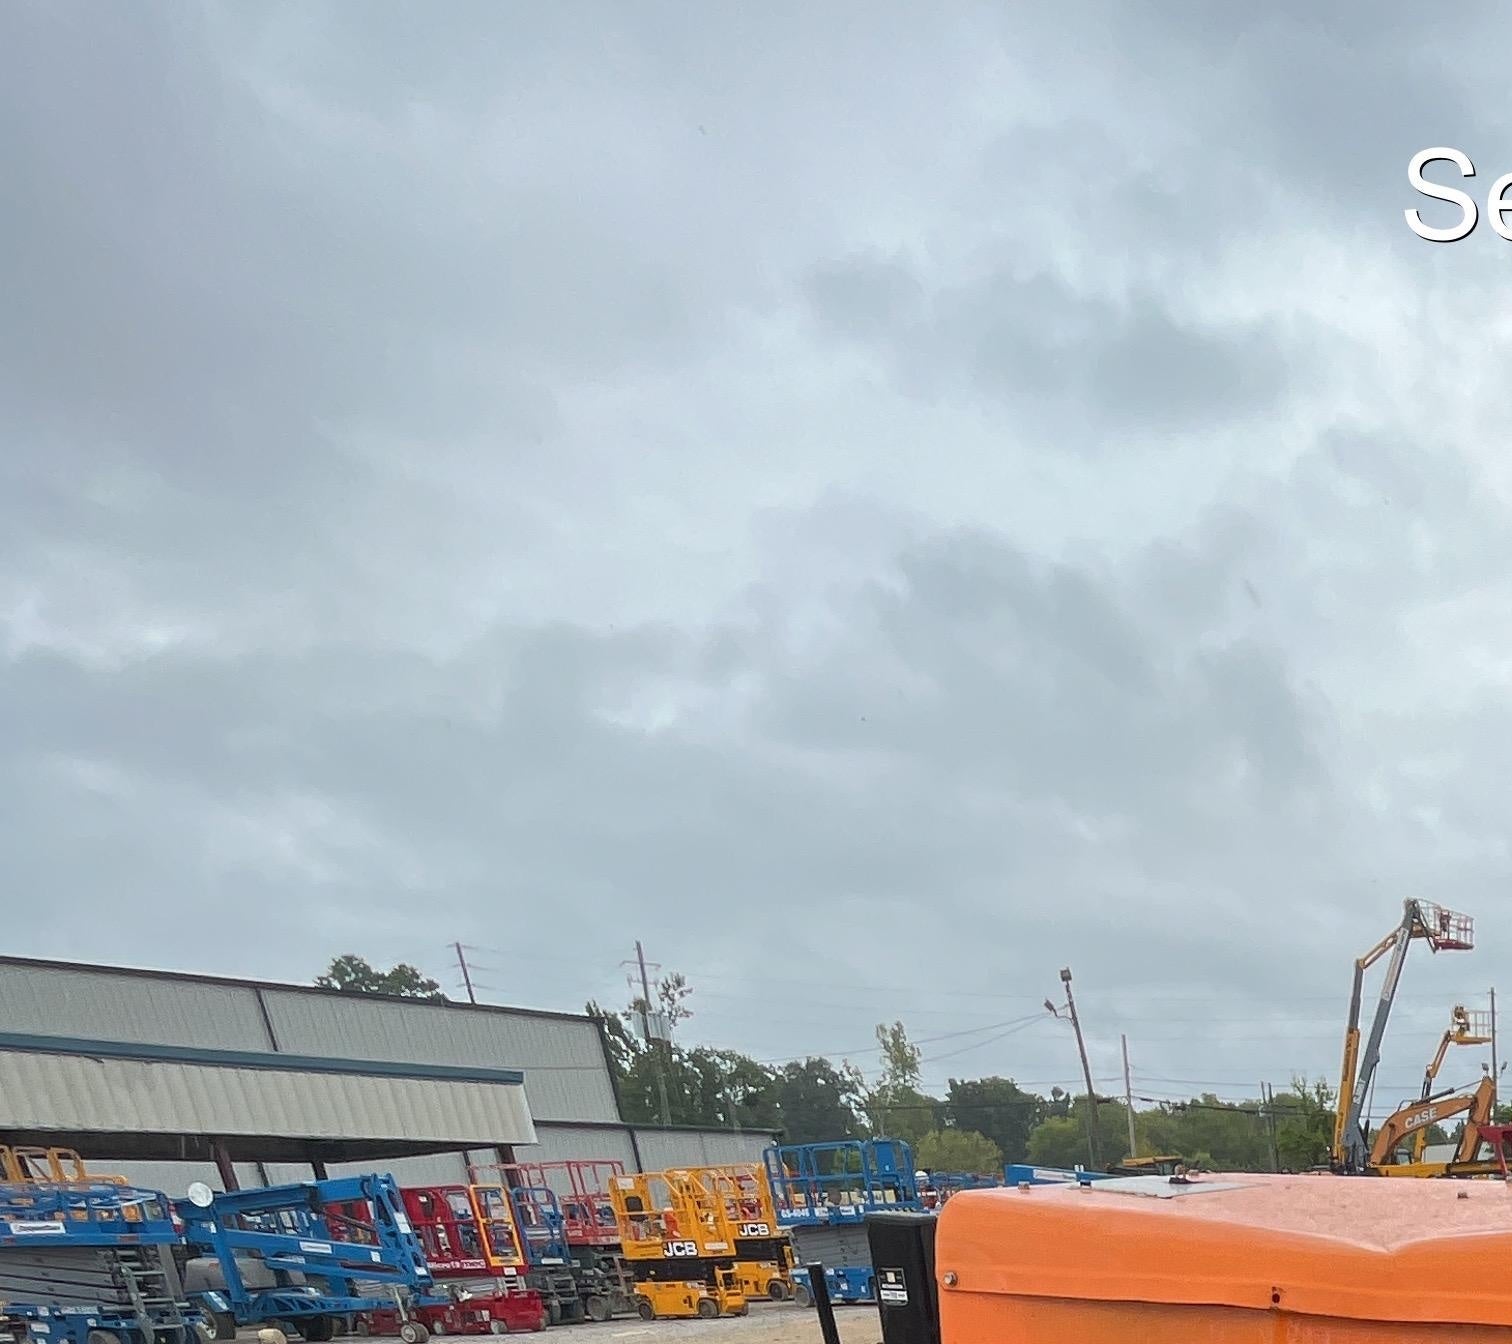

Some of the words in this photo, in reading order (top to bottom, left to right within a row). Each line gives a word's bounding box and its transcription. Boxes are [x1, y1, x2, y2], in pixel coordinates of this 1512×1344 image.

[1405, 1107, 1437, 1128] CASE
[739, 1223, 769, 1236] JCB
[664, 1241, 698, 1257] JCB
